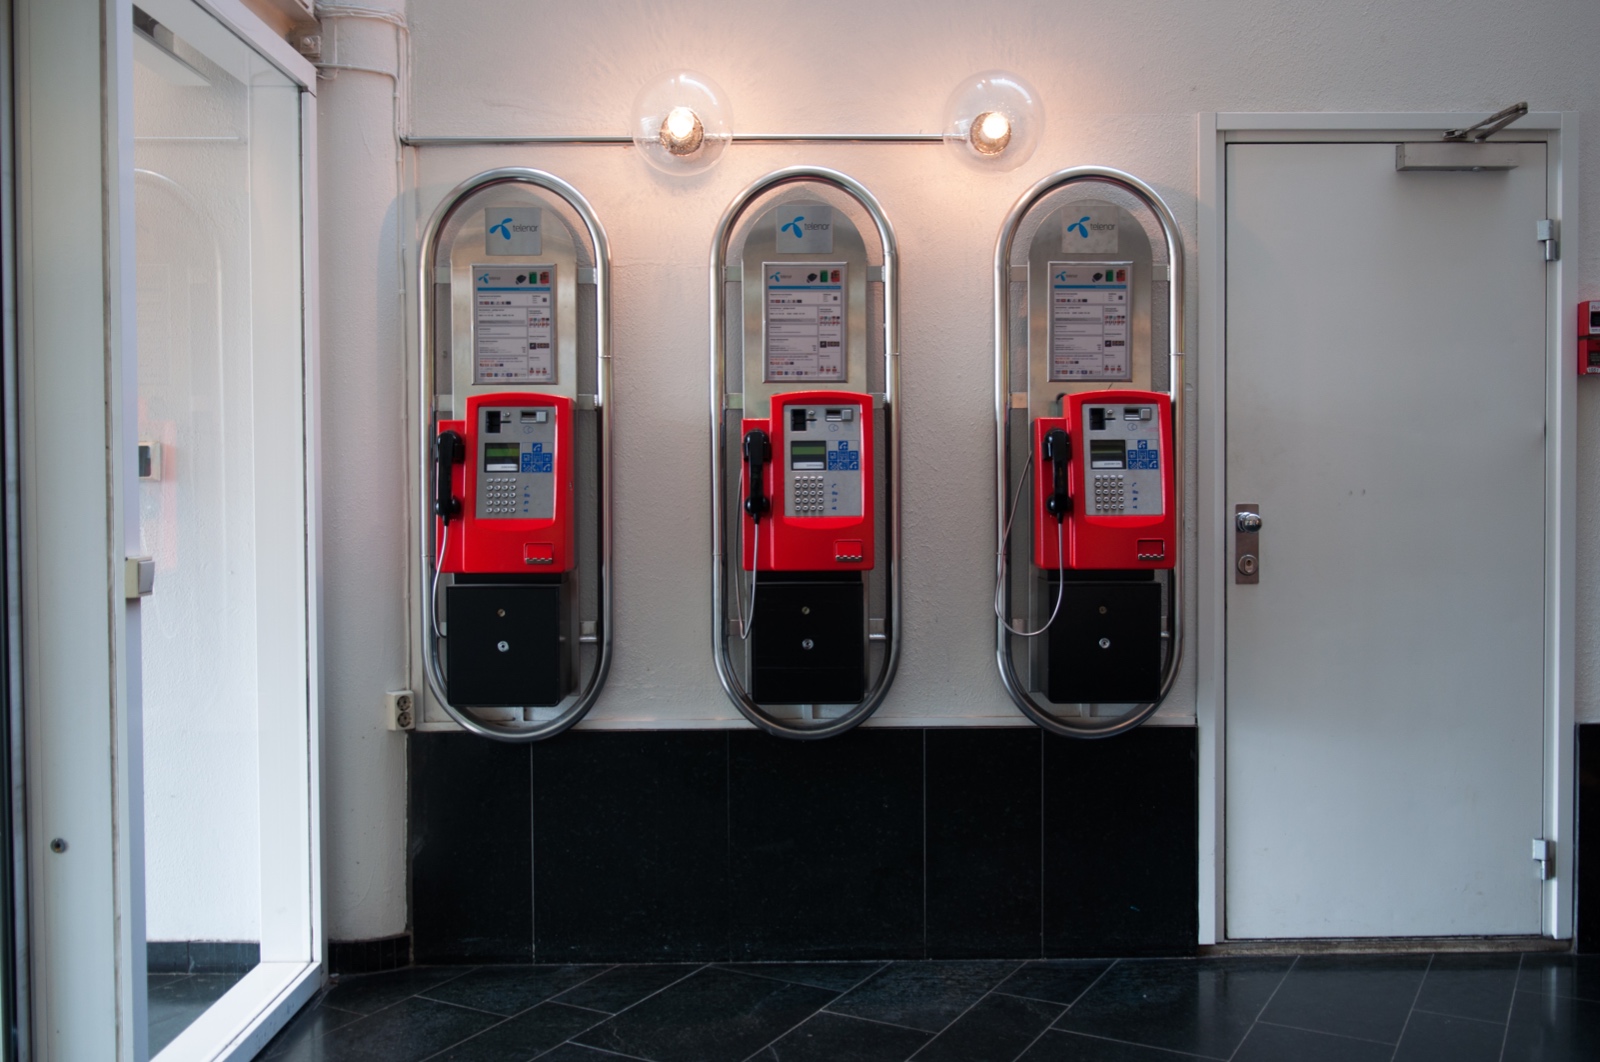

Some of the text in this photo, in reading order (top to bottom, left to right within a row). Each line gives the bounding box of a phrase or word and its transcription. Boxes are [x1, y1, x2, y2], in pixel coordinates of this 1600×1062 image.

[512, 224, 538, 232] telenor
[804, 222, 830, 230] telenor
[1090, 222, 1115, 230] telenor
